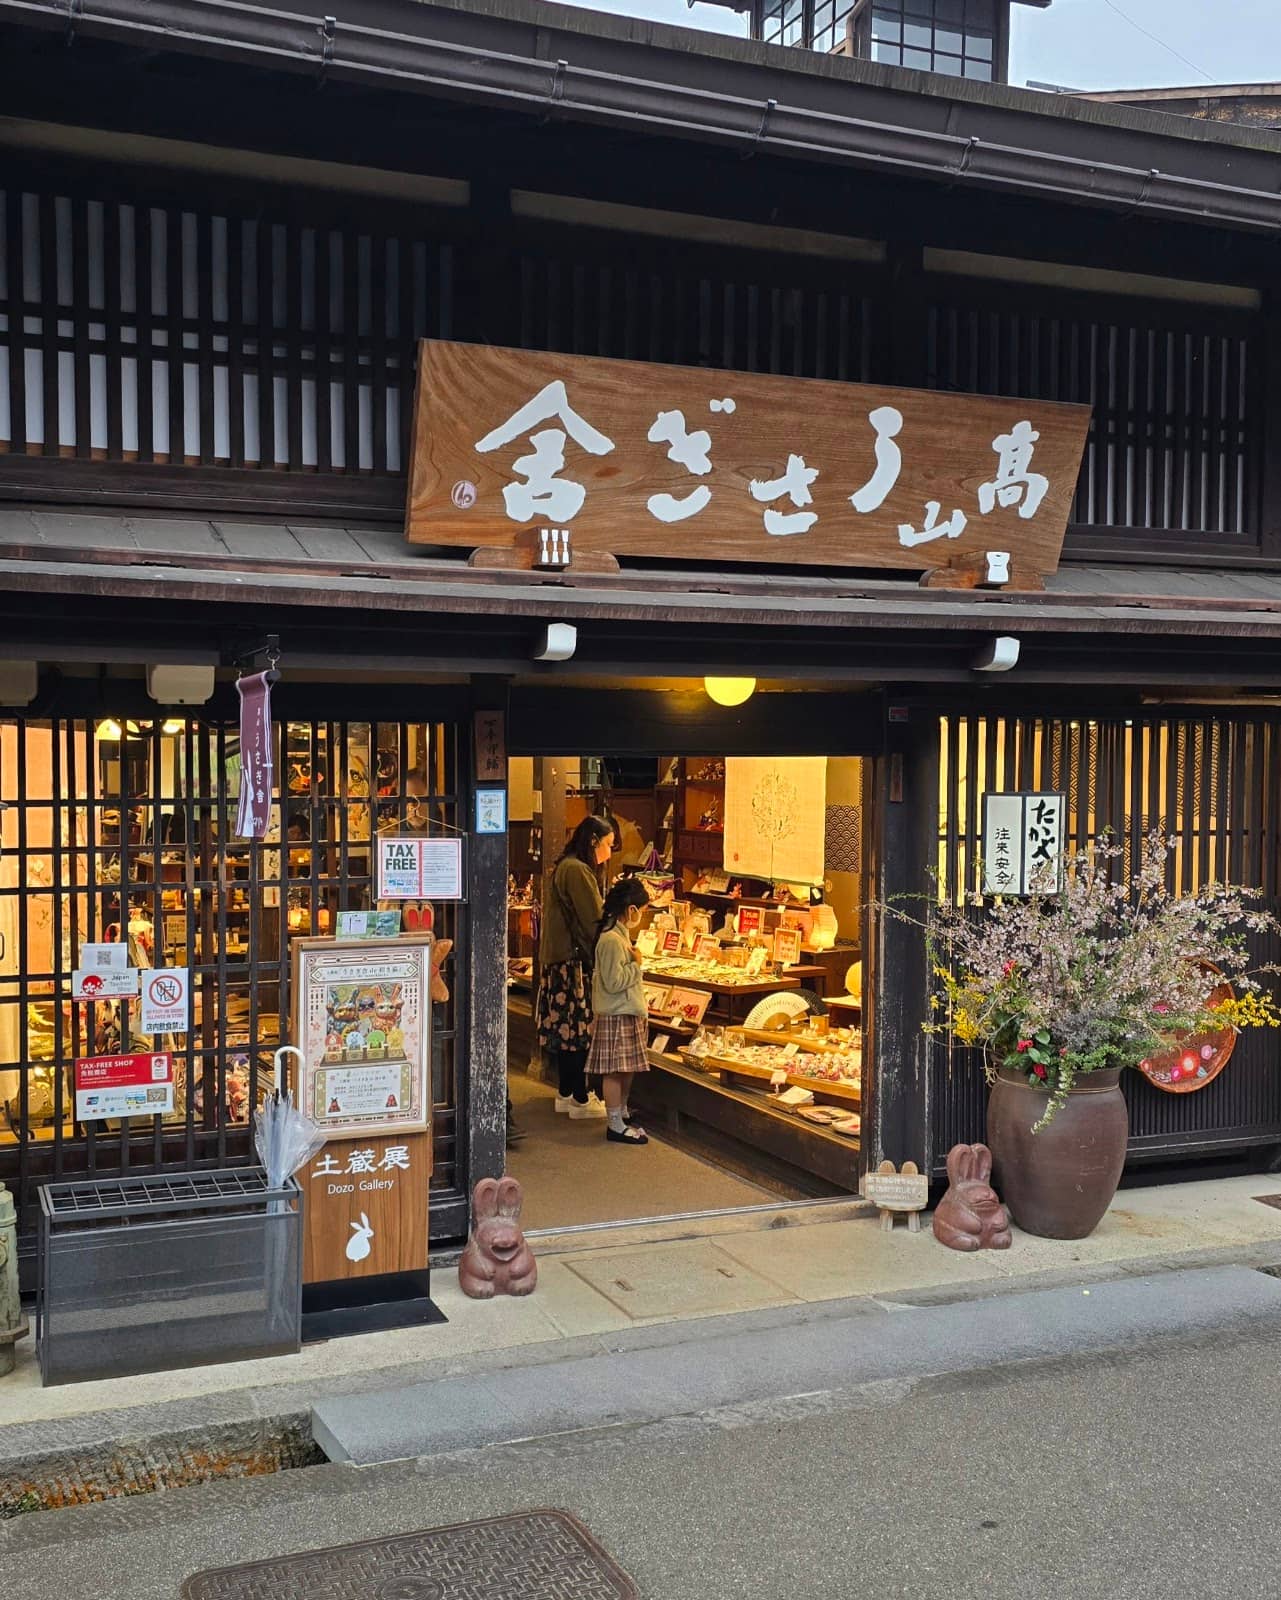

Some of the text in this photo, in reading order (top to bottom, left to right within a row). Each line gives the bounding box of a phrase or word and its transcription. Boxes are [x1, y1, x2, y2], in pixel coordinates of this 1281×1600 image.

[386, 844, 415, 858] TAX
[1028, 798, 1056, 890] たかや
[385, 858, 417, 871] FREE
[111, 974, 130, 982] Japan
[79, 1059, 134, 1070] TAX-FREE SHOP
[311, 1145, 411, 1179] 土蔵展
[327, 1179, 395, 1195] Dozo Gallery
